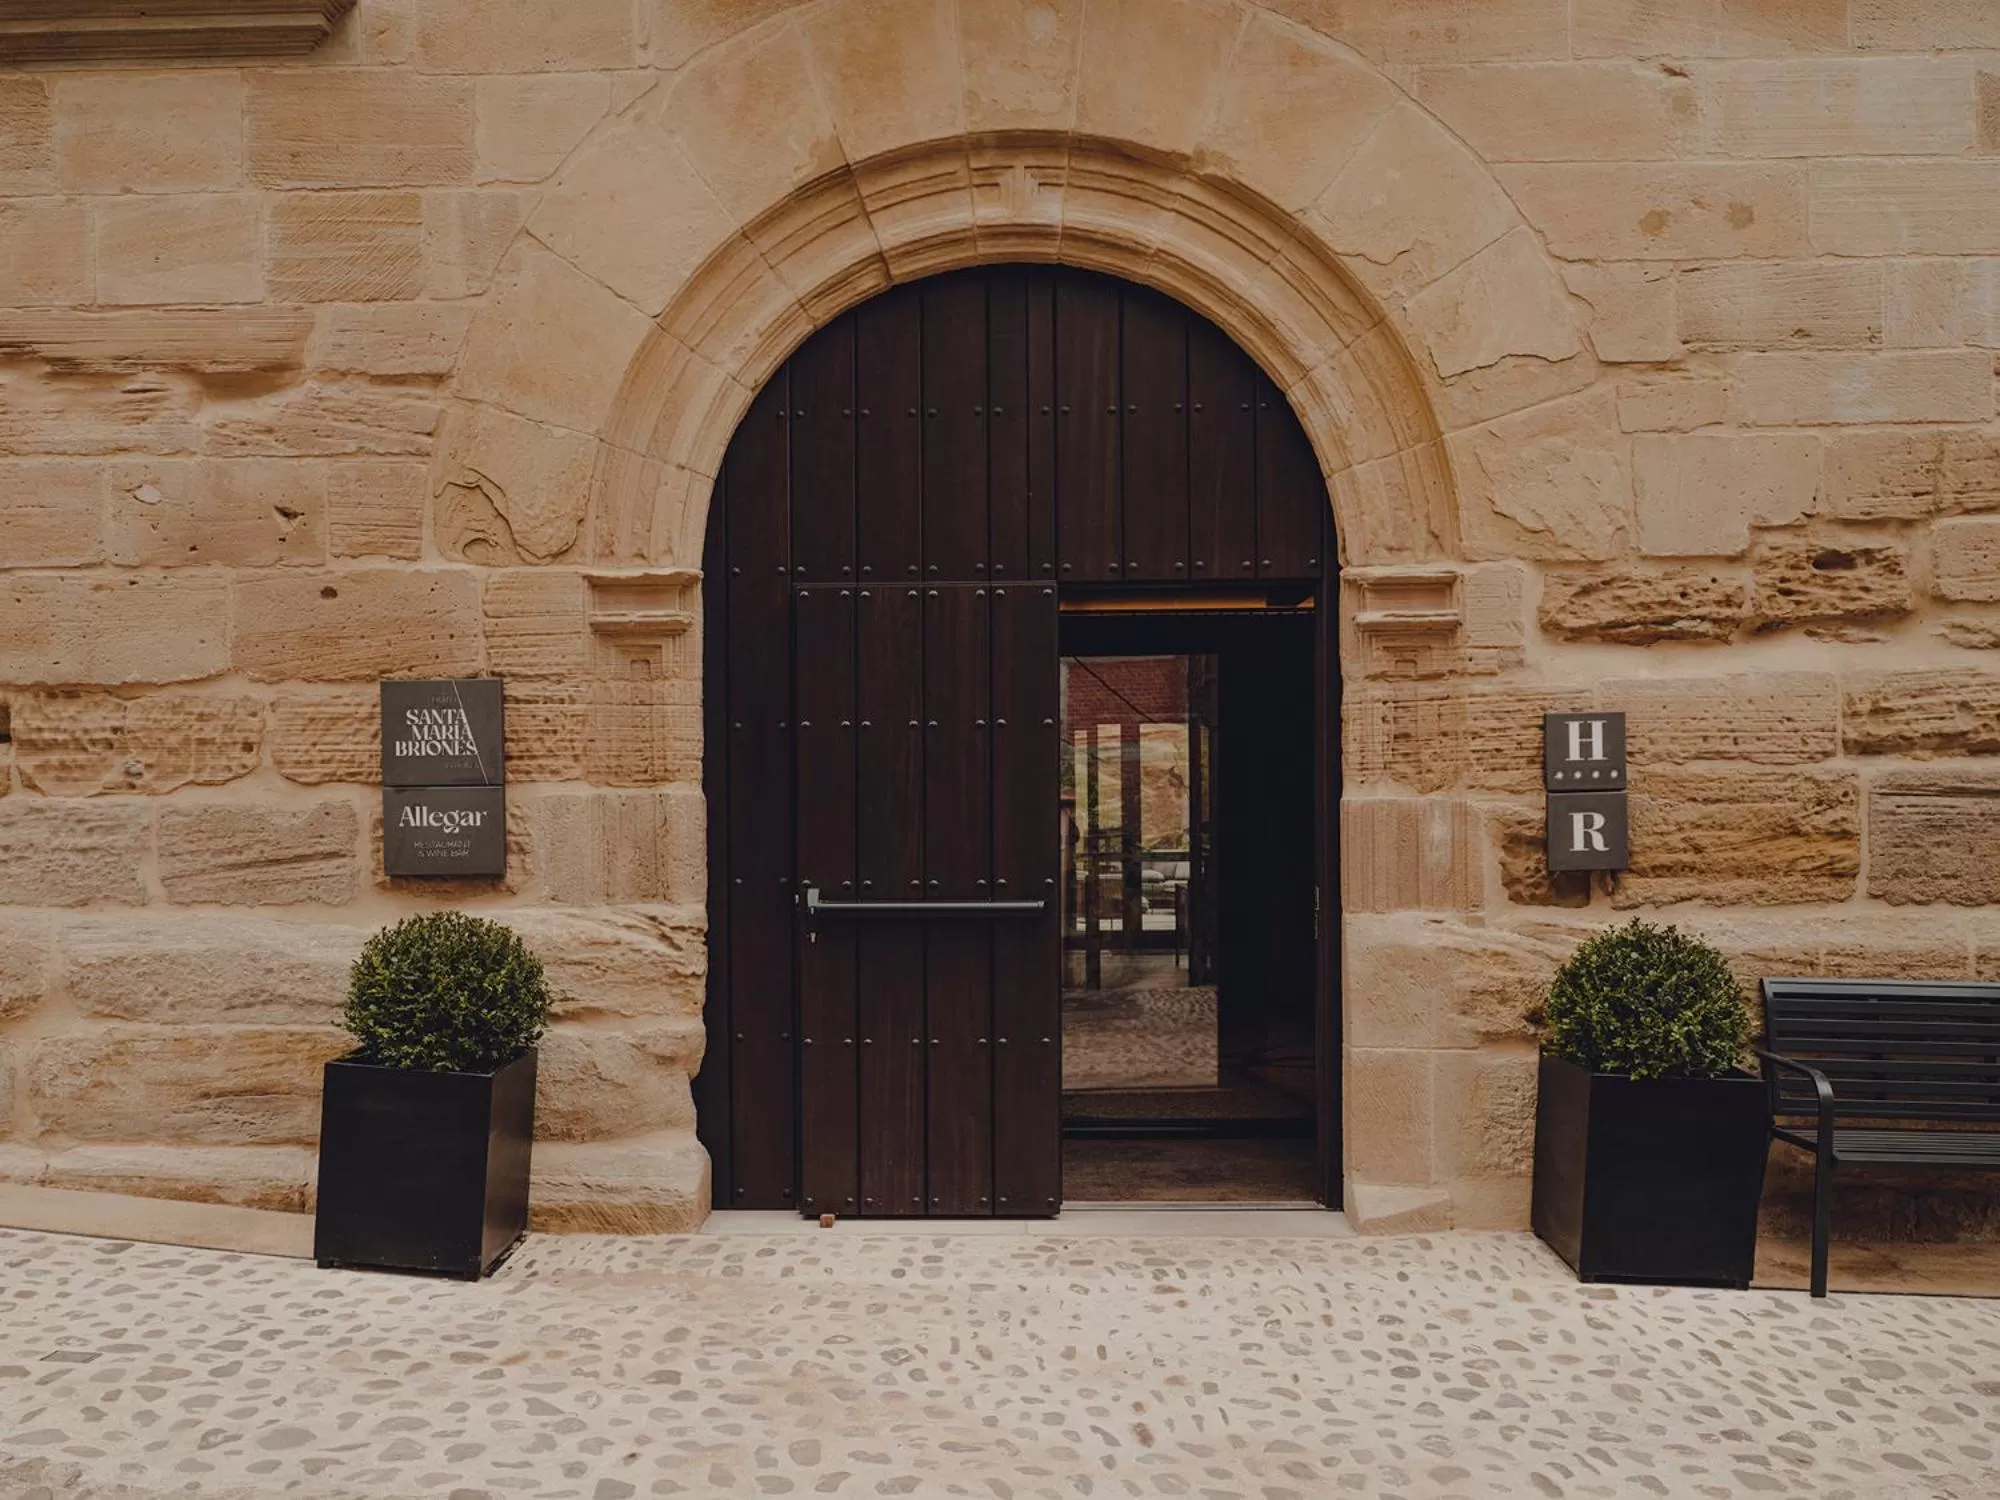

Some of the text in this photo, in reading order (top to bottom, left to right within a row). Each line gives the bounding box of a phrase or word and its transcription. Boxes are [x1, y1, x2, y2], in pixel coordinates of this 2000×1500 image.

[406, 708, 467, 725] SANTA
[395, 740, 478, 757] BRIONES
[1564, 720, 1608, 761] H
[399, 805, 487, 834] Allegar
[1568, 812, 1610, 852] R
